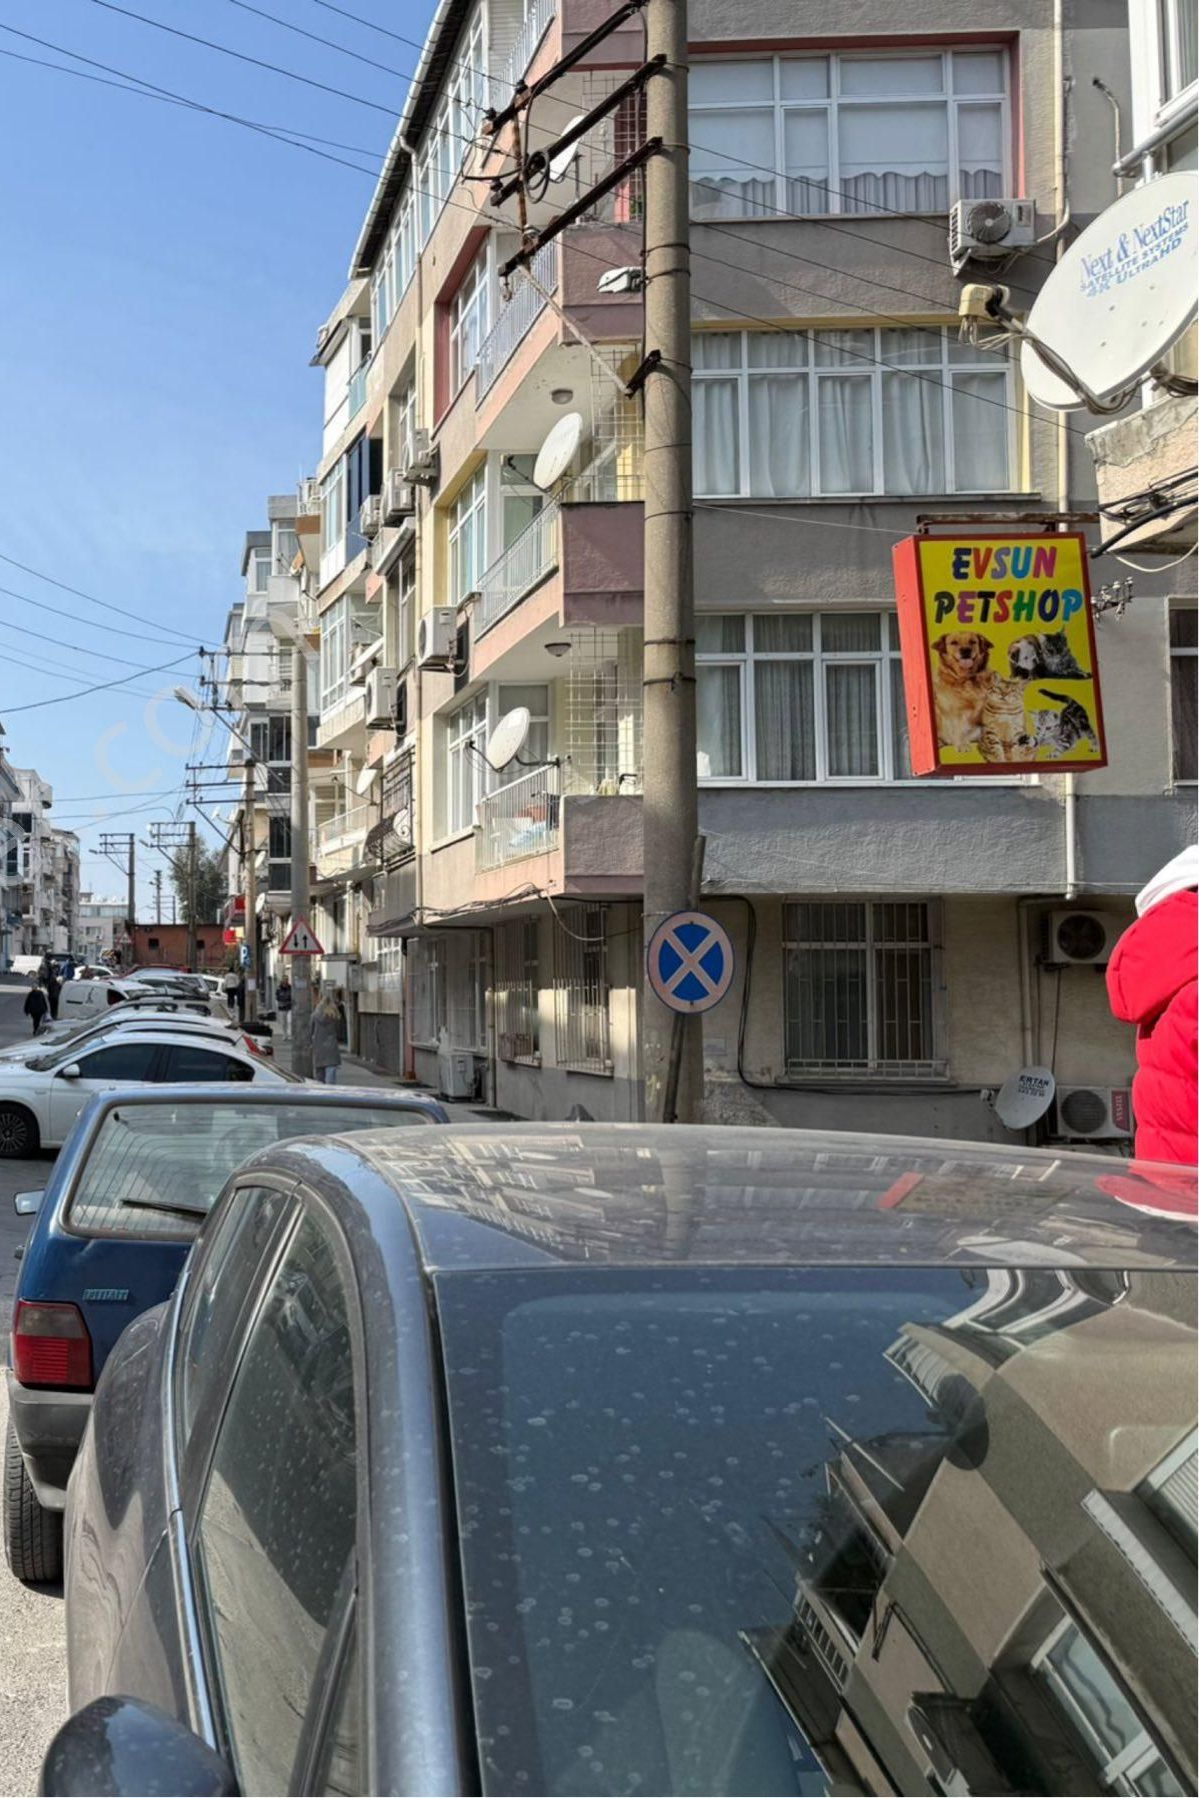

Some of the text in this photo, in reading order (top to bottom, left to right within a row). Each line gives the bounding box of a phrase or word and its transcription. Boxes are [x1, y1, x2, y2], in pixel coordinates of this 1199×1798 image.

[1080, 248, 1113, 281] Next
[1117, 233, 1129, 262] &
[952, 546, 1057, 580] EVSUN
[933, 589, 1083, 624] PETSHOP
